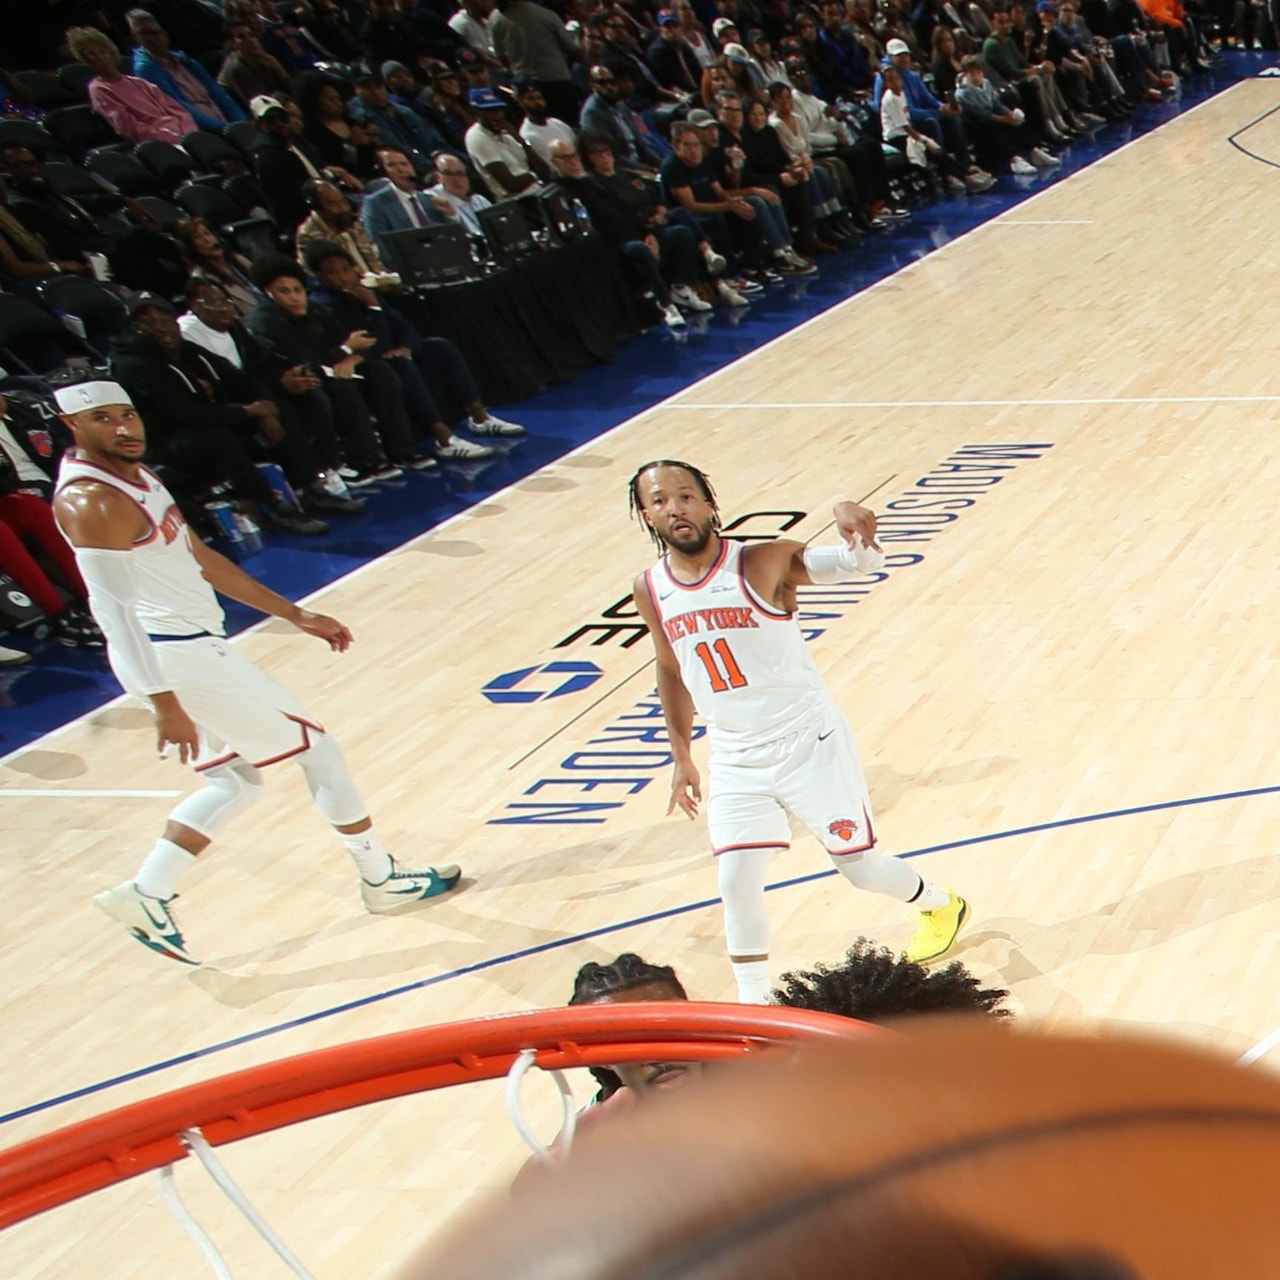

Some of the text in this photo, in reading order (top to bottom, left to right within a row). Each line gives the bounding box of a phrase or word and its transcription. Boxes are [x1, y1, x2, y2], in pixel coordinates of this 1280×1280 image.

[875, 443, 1055, 542] MADISON
[663, 606, 760, 643] NEW YORK
[694, 637, 749, 694] 11
